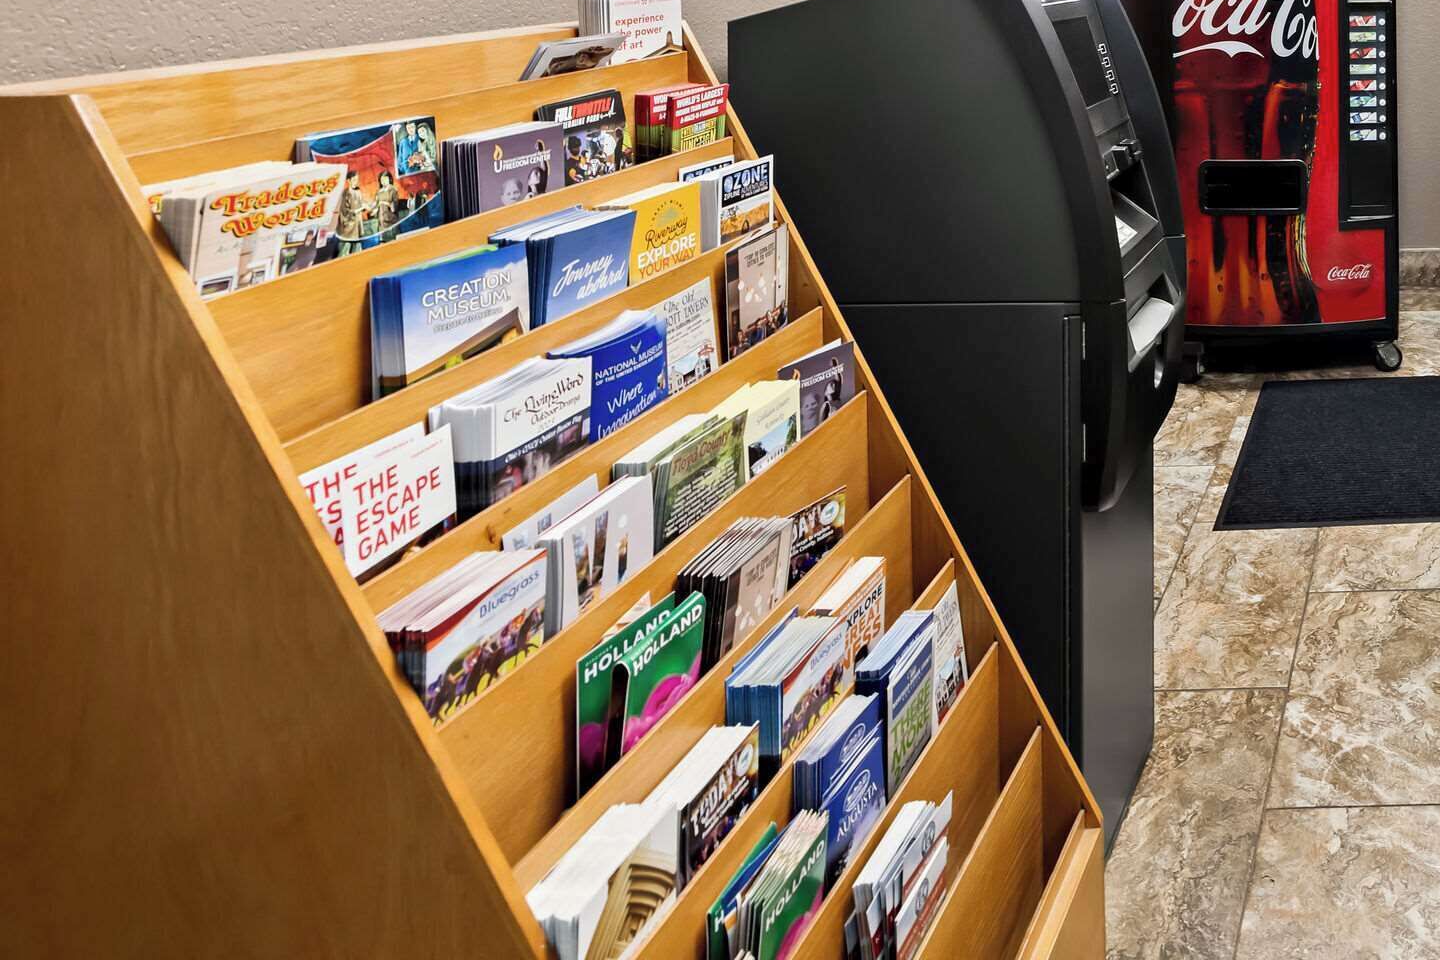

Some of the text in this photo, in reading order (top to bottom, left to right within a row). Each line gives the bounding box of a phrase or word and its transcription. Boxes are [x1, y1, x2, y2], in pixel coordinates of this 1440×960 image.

[615, 14, 665, 29] experience
[635, 26, 663, 39] power
[630, 40, 643, 50] art
[554, 105, 573, 123] FULL
[676, 92, 701, 109] WORLD'S
[701, 87, 724, 102] LARGEST
[502, 156, 530, 171] FREEDOM
[529, 152, 551, 164] CENTER
[723, 163, 768, 193] OZONE
[210, 170, 341, 217] Traders
[220, 196, 327, 239] World
[637, 232, 697, 269] EXPLORE
[638, 246, 697, 279] YOUR WAY
[421, 271, 512, 308] CREATION
[552, 252, 615, 298] Journey
[576, 261, 626, 300] aboard
[1327, 263, 1372, 281] Coca-Cola
[427, 289, 511, 325] MUSEUM
[595, 340, 664, 380] NATIONAL MUSEUM
[524, 390, 560, 414] Living
[556, 373, 584, 395] Word
[607, 381, 644, 414] Where
[672, 429, 729, 477] Floyd County
[304, 463, 360, 505] THE
[353, 464, 399, 506] THE
[357, 465, 442, 536] ESCAPE
[357, 505, 421, 562] GAME
[479, 570, 540, 619] Bluegrass
[584, 609, 672, 685] HOLLAND
[632, 604, 703, 677] HOLLAND
[836, 781, 878, 843] AUGUSTA
[765, 840, 825, 933] HOLLAND
